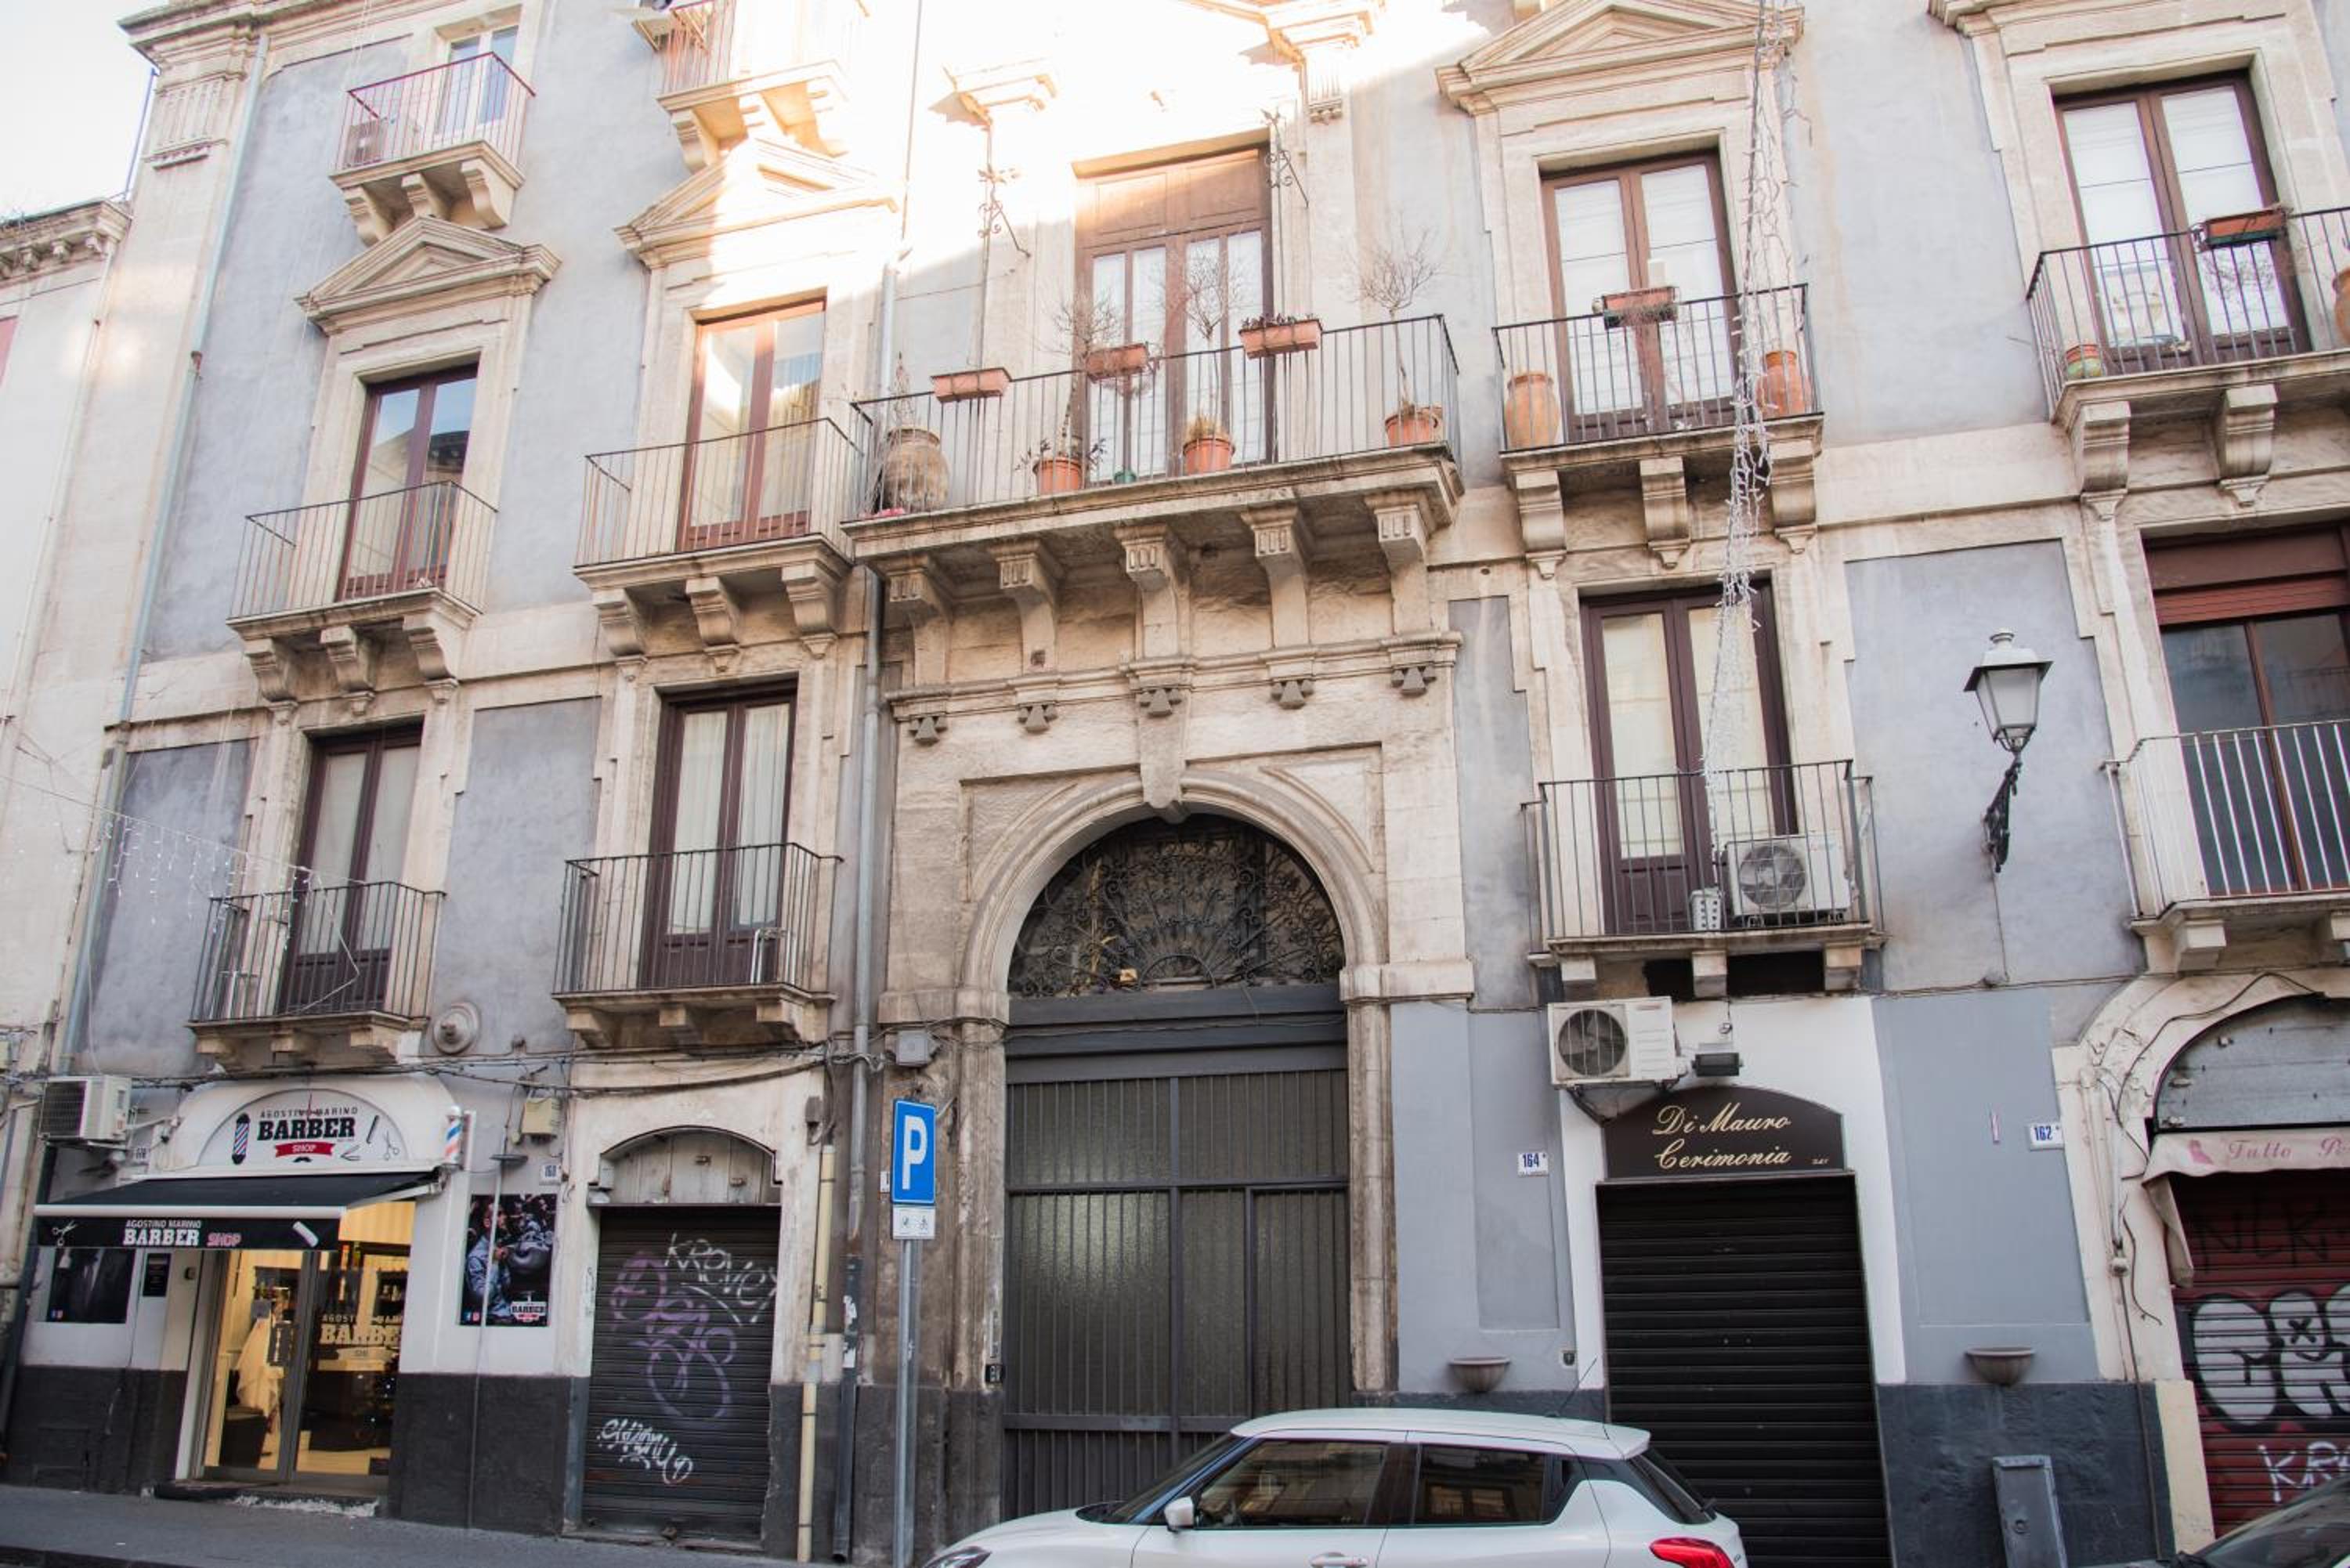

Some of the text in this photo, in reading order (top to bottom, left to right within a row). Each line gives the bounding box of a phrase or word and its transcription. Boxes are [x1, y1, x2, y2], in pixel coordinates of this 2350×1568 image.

[257, 1117, 356, 1141] BARBER
[1652, 1101, 1791, 1135] Di Mauro
[902, 1115, 928, 1190] P
[1522, 1152, 1539, 1168] 164
[1654, 1138, 1792, 1169] Cerimonia
[125, 1219, 201, 1228] AGOSTINO MARINO
[123, 1228, 242, 1247] BARBER SHOP
